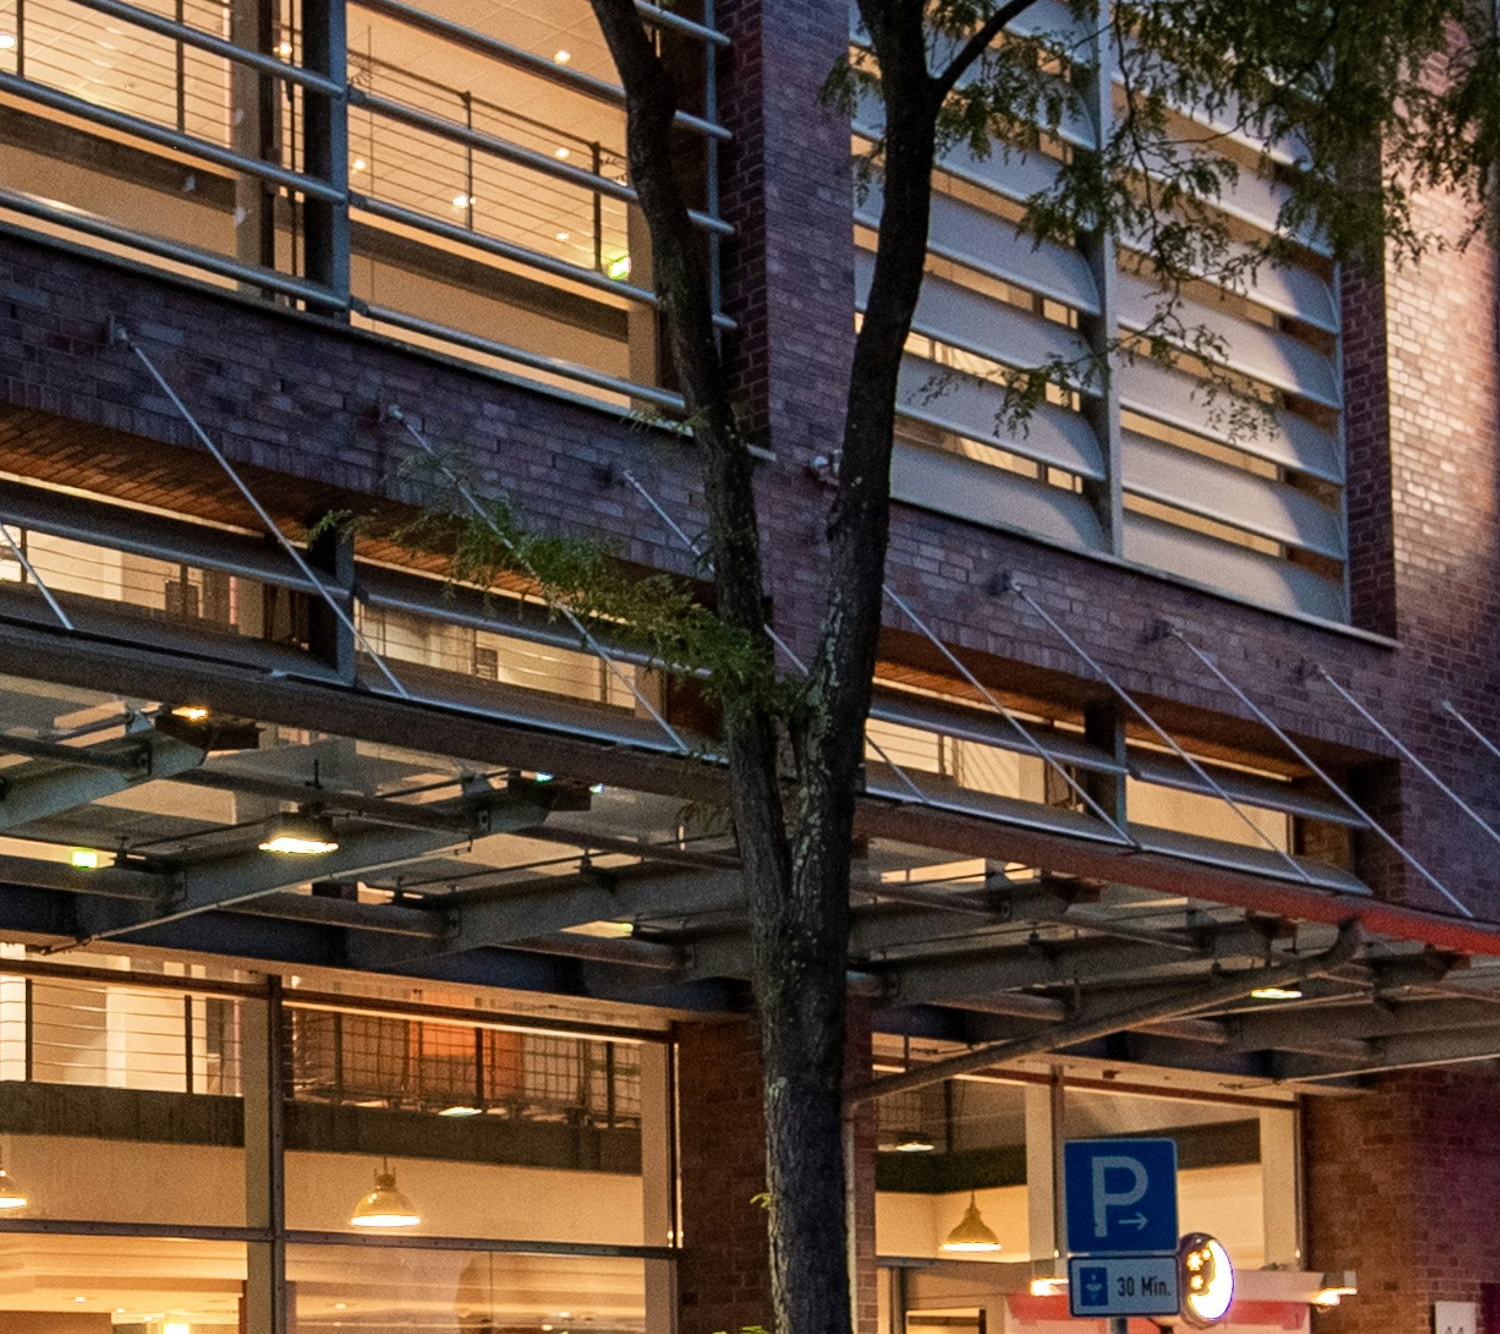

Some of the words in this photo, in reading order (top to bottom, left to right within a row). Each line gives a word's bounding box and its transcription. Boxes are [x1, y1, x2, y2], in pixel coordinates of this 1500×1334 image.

[1091, 1156, 1149, 1238] P
[1117, 1277, 1134, 1297] 30
[1141, 1275, 1171, 1297] Min.
